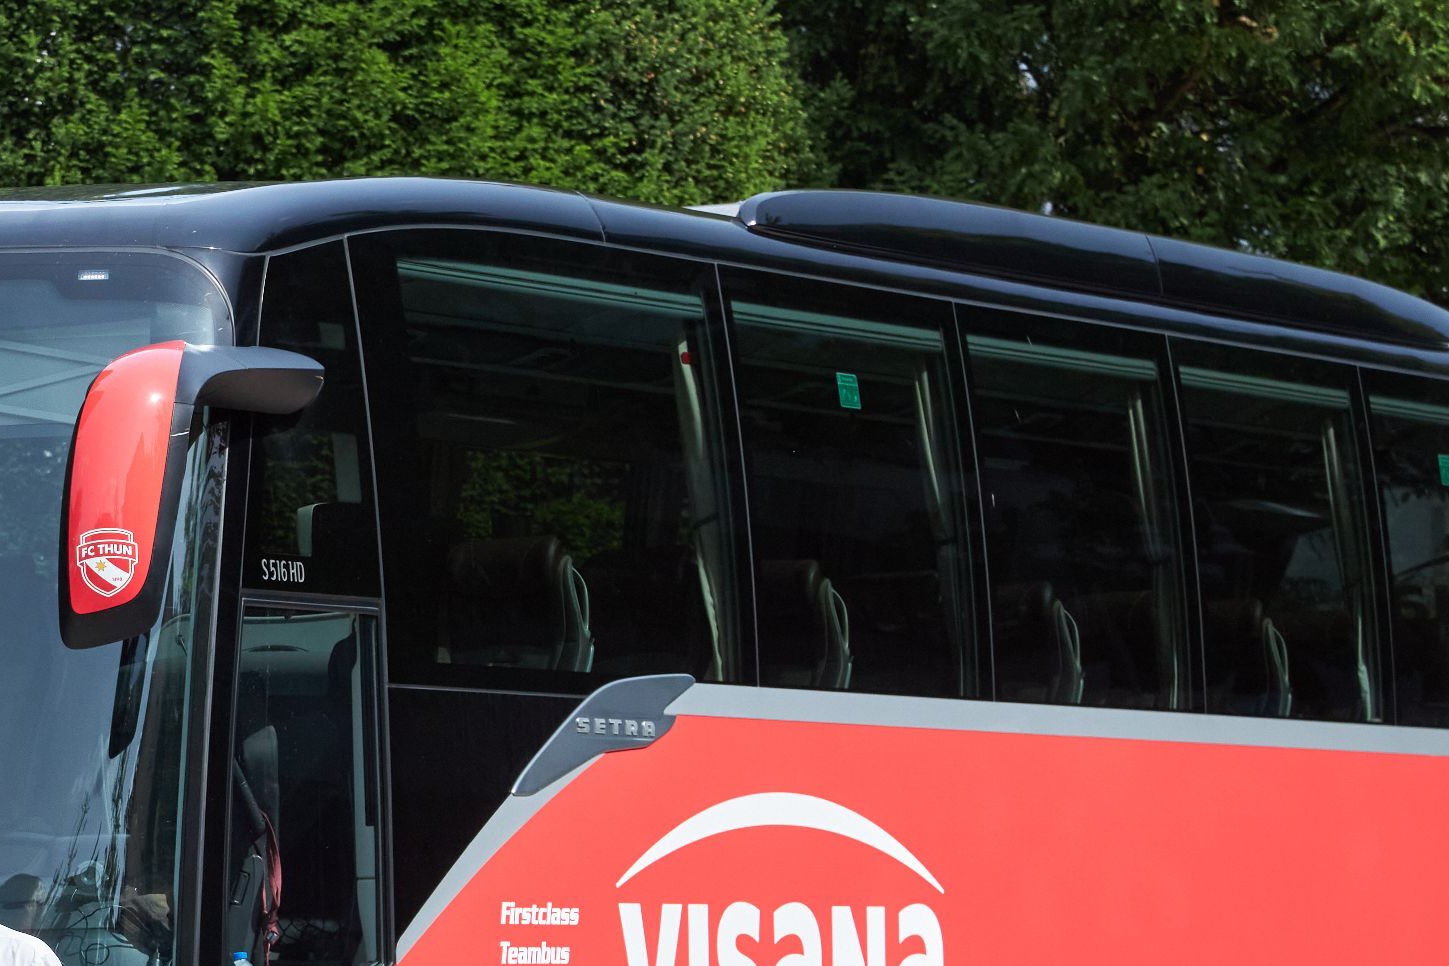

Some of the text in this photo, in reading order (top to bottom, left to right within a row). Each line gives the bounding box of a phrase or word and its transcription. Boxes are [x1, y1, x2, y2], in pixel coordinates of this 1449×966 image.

[81, 543, 133, 558] FC THUN
[575, 717, 656, 737] SETRA
[500, 901, 580, 926] Firstclass
[499, 941, 571, 965] Teambus
